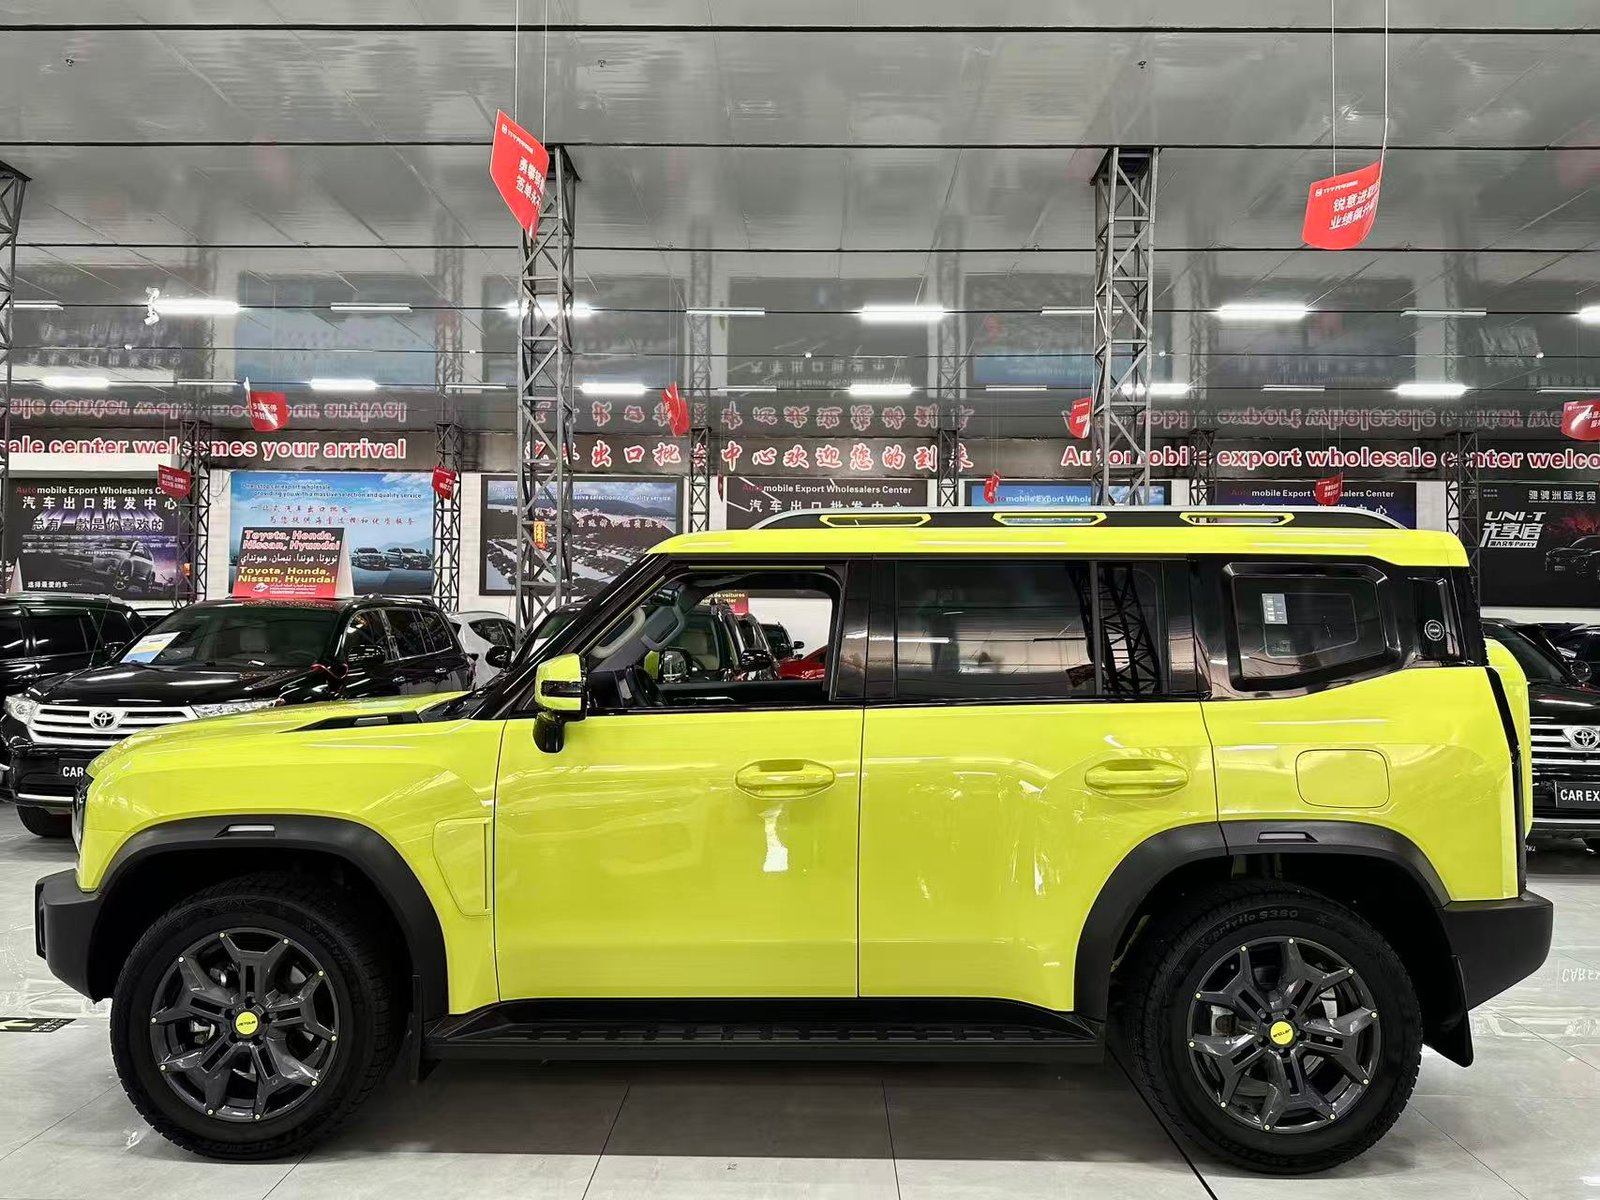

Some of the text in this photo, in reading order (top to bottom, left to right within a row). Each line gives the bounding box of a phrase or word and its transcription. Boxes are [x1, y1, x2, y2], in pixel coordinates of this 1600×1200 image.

[49, 437, 130, 455] center
[261, 440, 320, 461] your
[323, 437, 407, 459] arrival
[1216, 447, 1302, 470] export
[1306, 446, 1437, 468] wholesale
[68, 486, 98, 497] Export
[99, 486, 154, 496] Wholesalers
[795, 485, 825, 494] Export
[826, 484, 881, 494] Wholesalers
[882, 485, 912, 494] Center
[1282, 489, 1310, 499] Export
[1366, 490, 1394, 499] Center
[22, 495, 178, 510] 汽车出口批发中心
[1035, 495, 1065, 505] Export
[1485, 511, 1547, 521] UNI-T
[32, 516, 165, 532] 总有一款是你喜欢的
[244, 530, 336, 541] Toyota, Honda,
[242, 540, 341, 551] Nissan, Hyundai
[239, 566, 330, 576] Toyota, Honda,
[237, 575, 336, 584] Nissan, Hyundai
[62, 766, 85, 777] CAR
[1560, 789, 1584, 801] CAR
